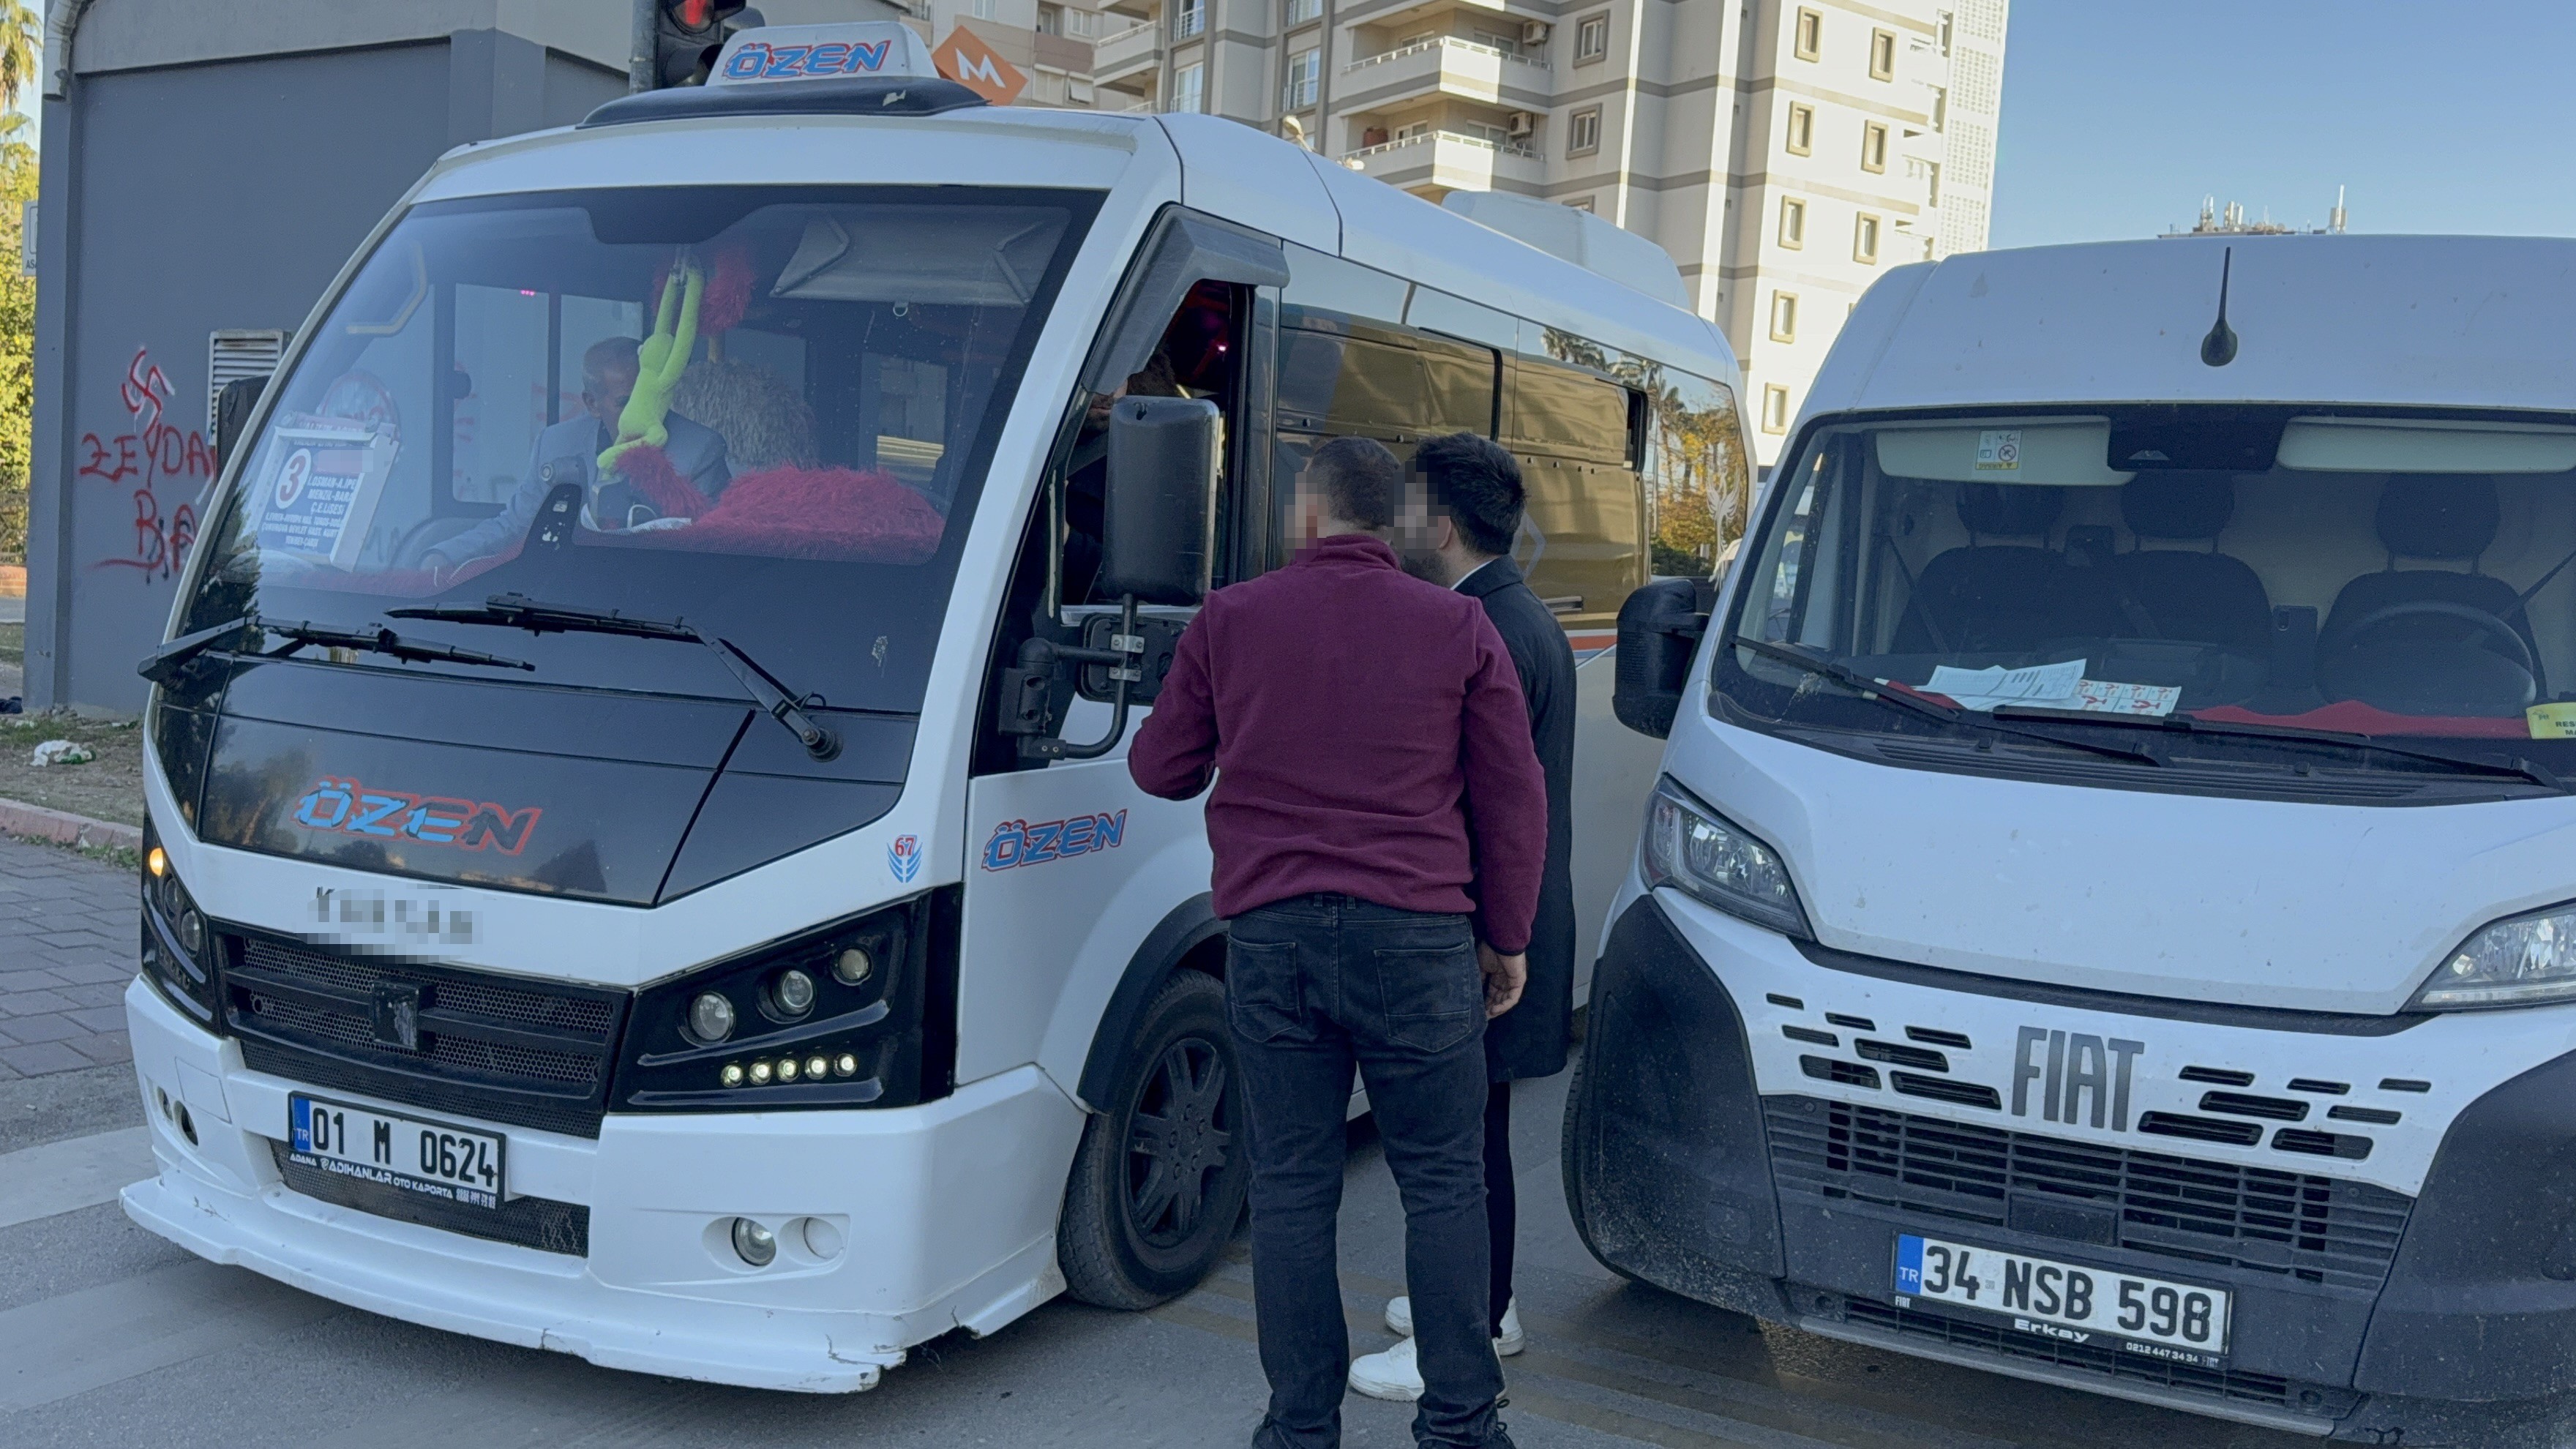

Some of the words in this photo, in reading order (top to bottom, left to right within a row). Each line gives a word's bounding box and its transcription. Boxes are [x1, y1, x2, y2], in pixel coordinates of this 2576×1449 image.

[722, 39, 891, 80] ÖZEN
[955, 47, 1006, 89] M
[26, 258, 36, 269] AS
[79, 422, 217, 489] ZEYDA
[280, 455, 306, 501] 3
[293, 774, 542, 855] ÖZEN
[894, 836, 916, 856] 67
[981, 809, 1128, 872] ÖZEN
[2012, 1025, 2145, 1132] FIAT
[296, 1128, 309, 1142] TR
[312, 1107, 344, 1155] 01
[374, 1120, 390, 1165] M
[420, 1129, 495, 1188] 0624
[290, 1153, 317, 1167] ADANA
[394, 1177, 411, 1189] OTO
[411, 1180, 453, 1199] KAPORTA
[1895, 1295, 1912, 1308] FIAT
[1900, 1266, 1918, 1283] TR
[1924, 1246, 1980, 1300] 34
[2002, 1259, 2093, 1320] NSB
[2117, 1279, 2212, 1343] 598
[2015, 1318, 2089, 1343] Erkay
[2126, 1342, 2151, 1354] 0212
[2152, 1347, 2171, 1358] 447
[2171, 1351, 2184, 1360] 34
[2186, 1354, 2198, 1363] 34
